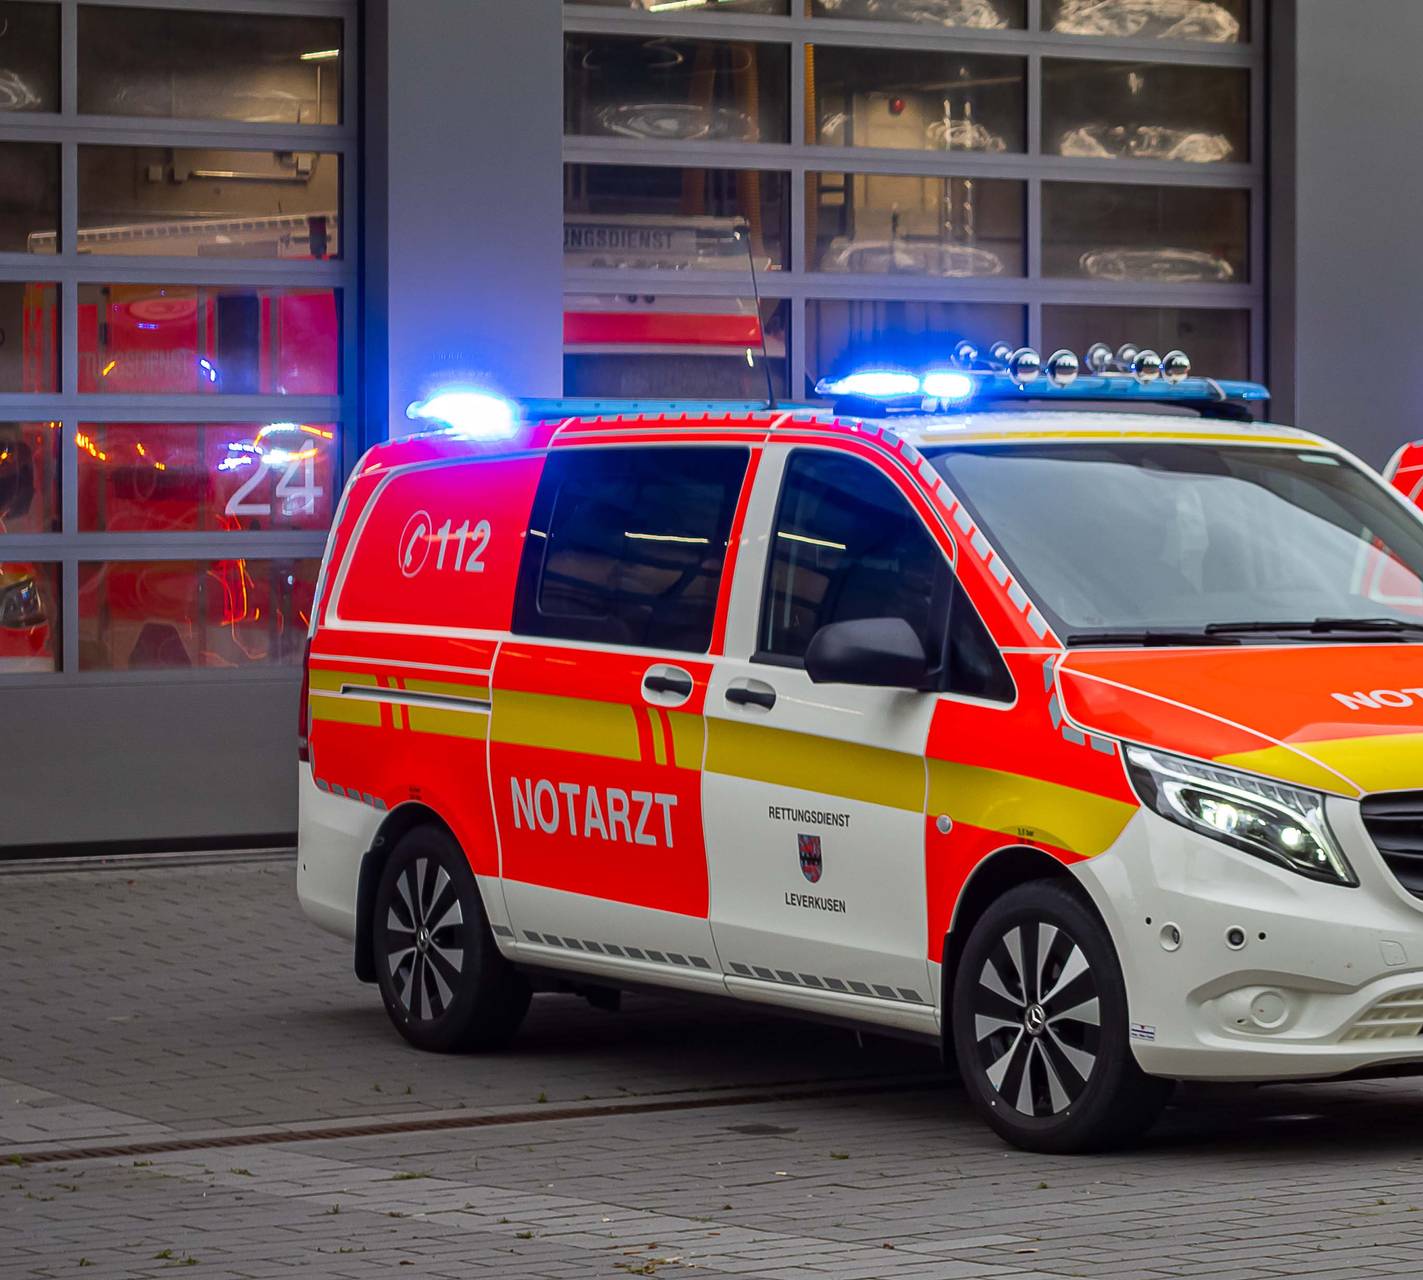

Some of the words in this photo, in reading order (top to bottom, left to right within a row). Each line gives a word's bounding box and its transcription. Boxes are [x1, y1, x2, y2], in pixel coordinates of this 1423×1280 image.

[225, 439, 323, 515] 24
[436, 518, 491, 573] 112
[510, 776, 678, 849] NOTARZT
[768, 805, 850, 827] RETTUNGSDIENST
[784, 891, 846, 914] LEVERKUSEN
